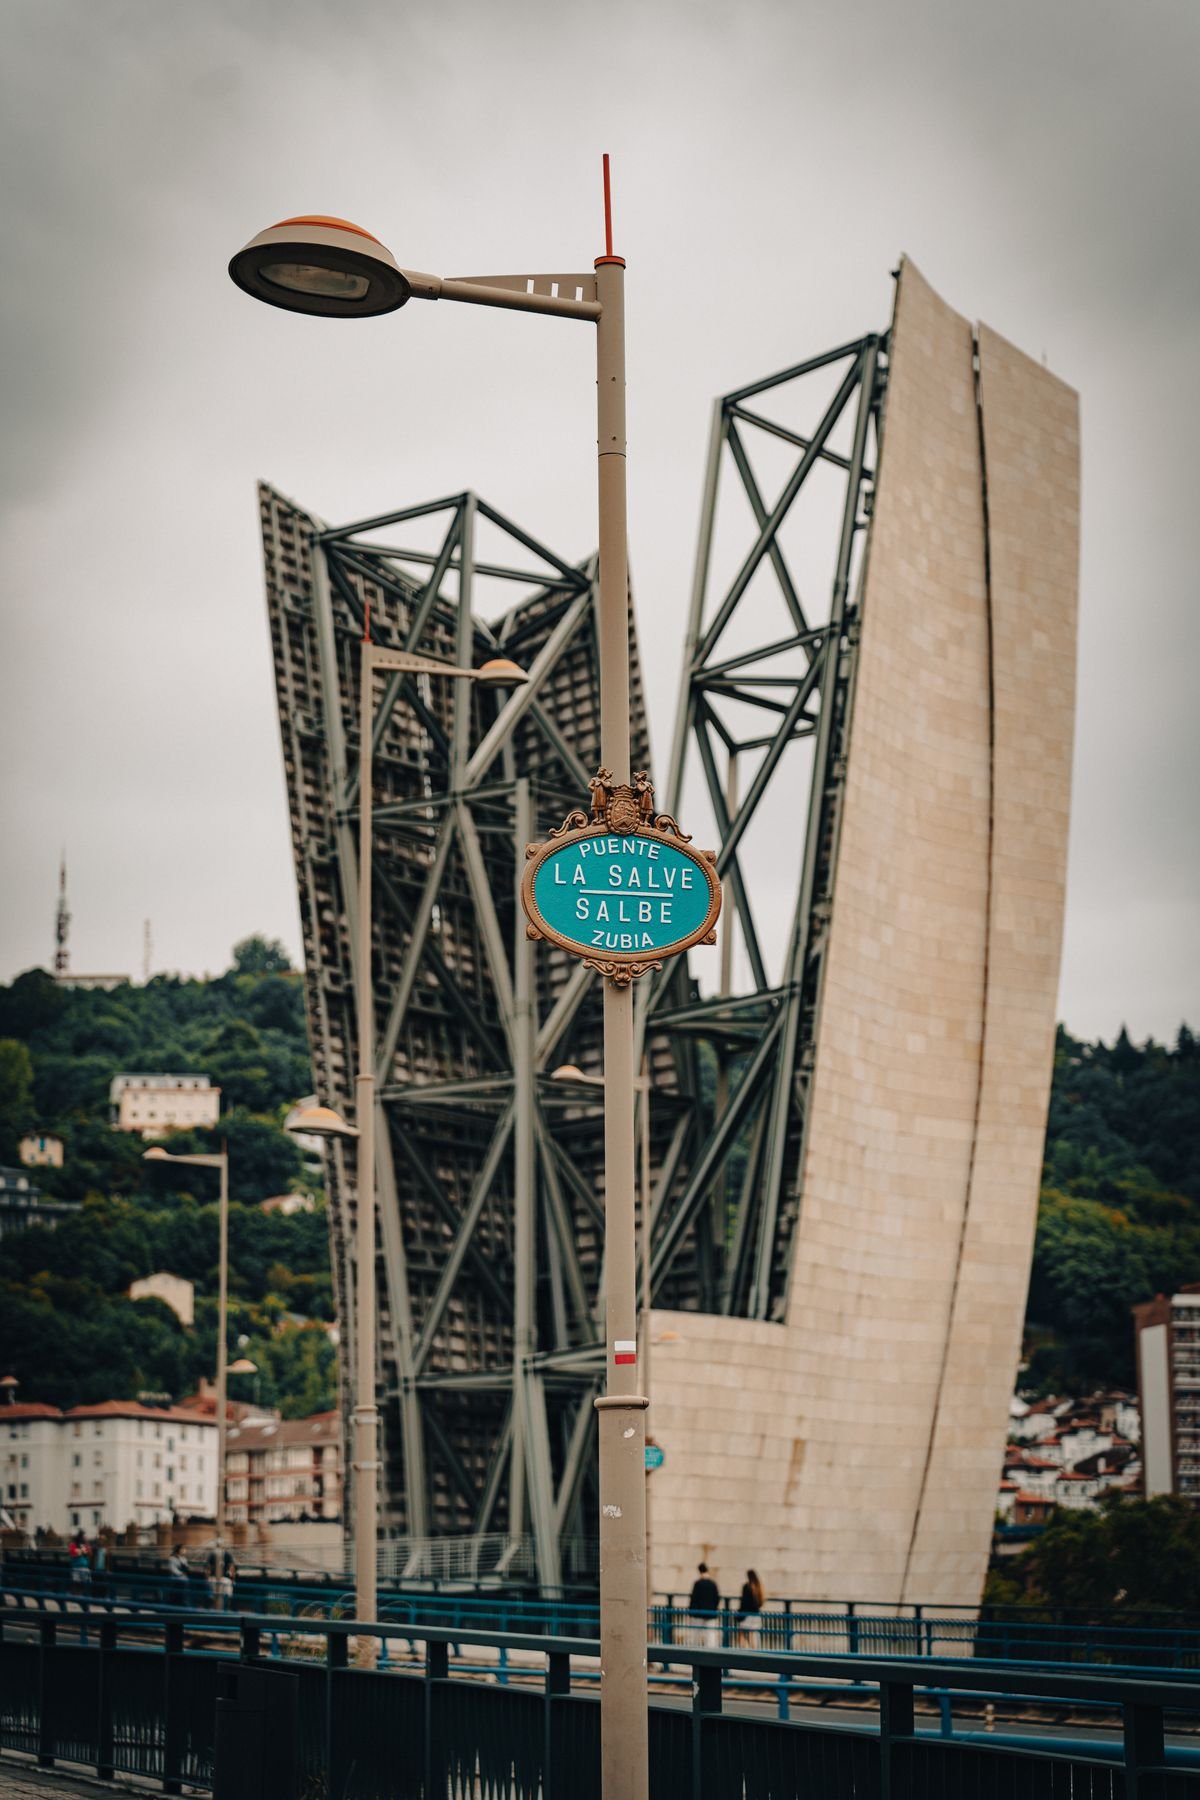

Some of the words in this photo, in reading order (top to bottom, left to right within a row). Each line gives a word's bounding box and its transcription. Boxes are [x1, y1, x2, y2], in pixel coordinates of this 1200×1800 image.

[578, 838, 661, 860] PUENTE
[554, 863, 586, 885] LA
[608, 864, 693, 889] SALVE
[575, 897, 673, 924] SALBE
[591, 930, 654, 949] ZUBIA
